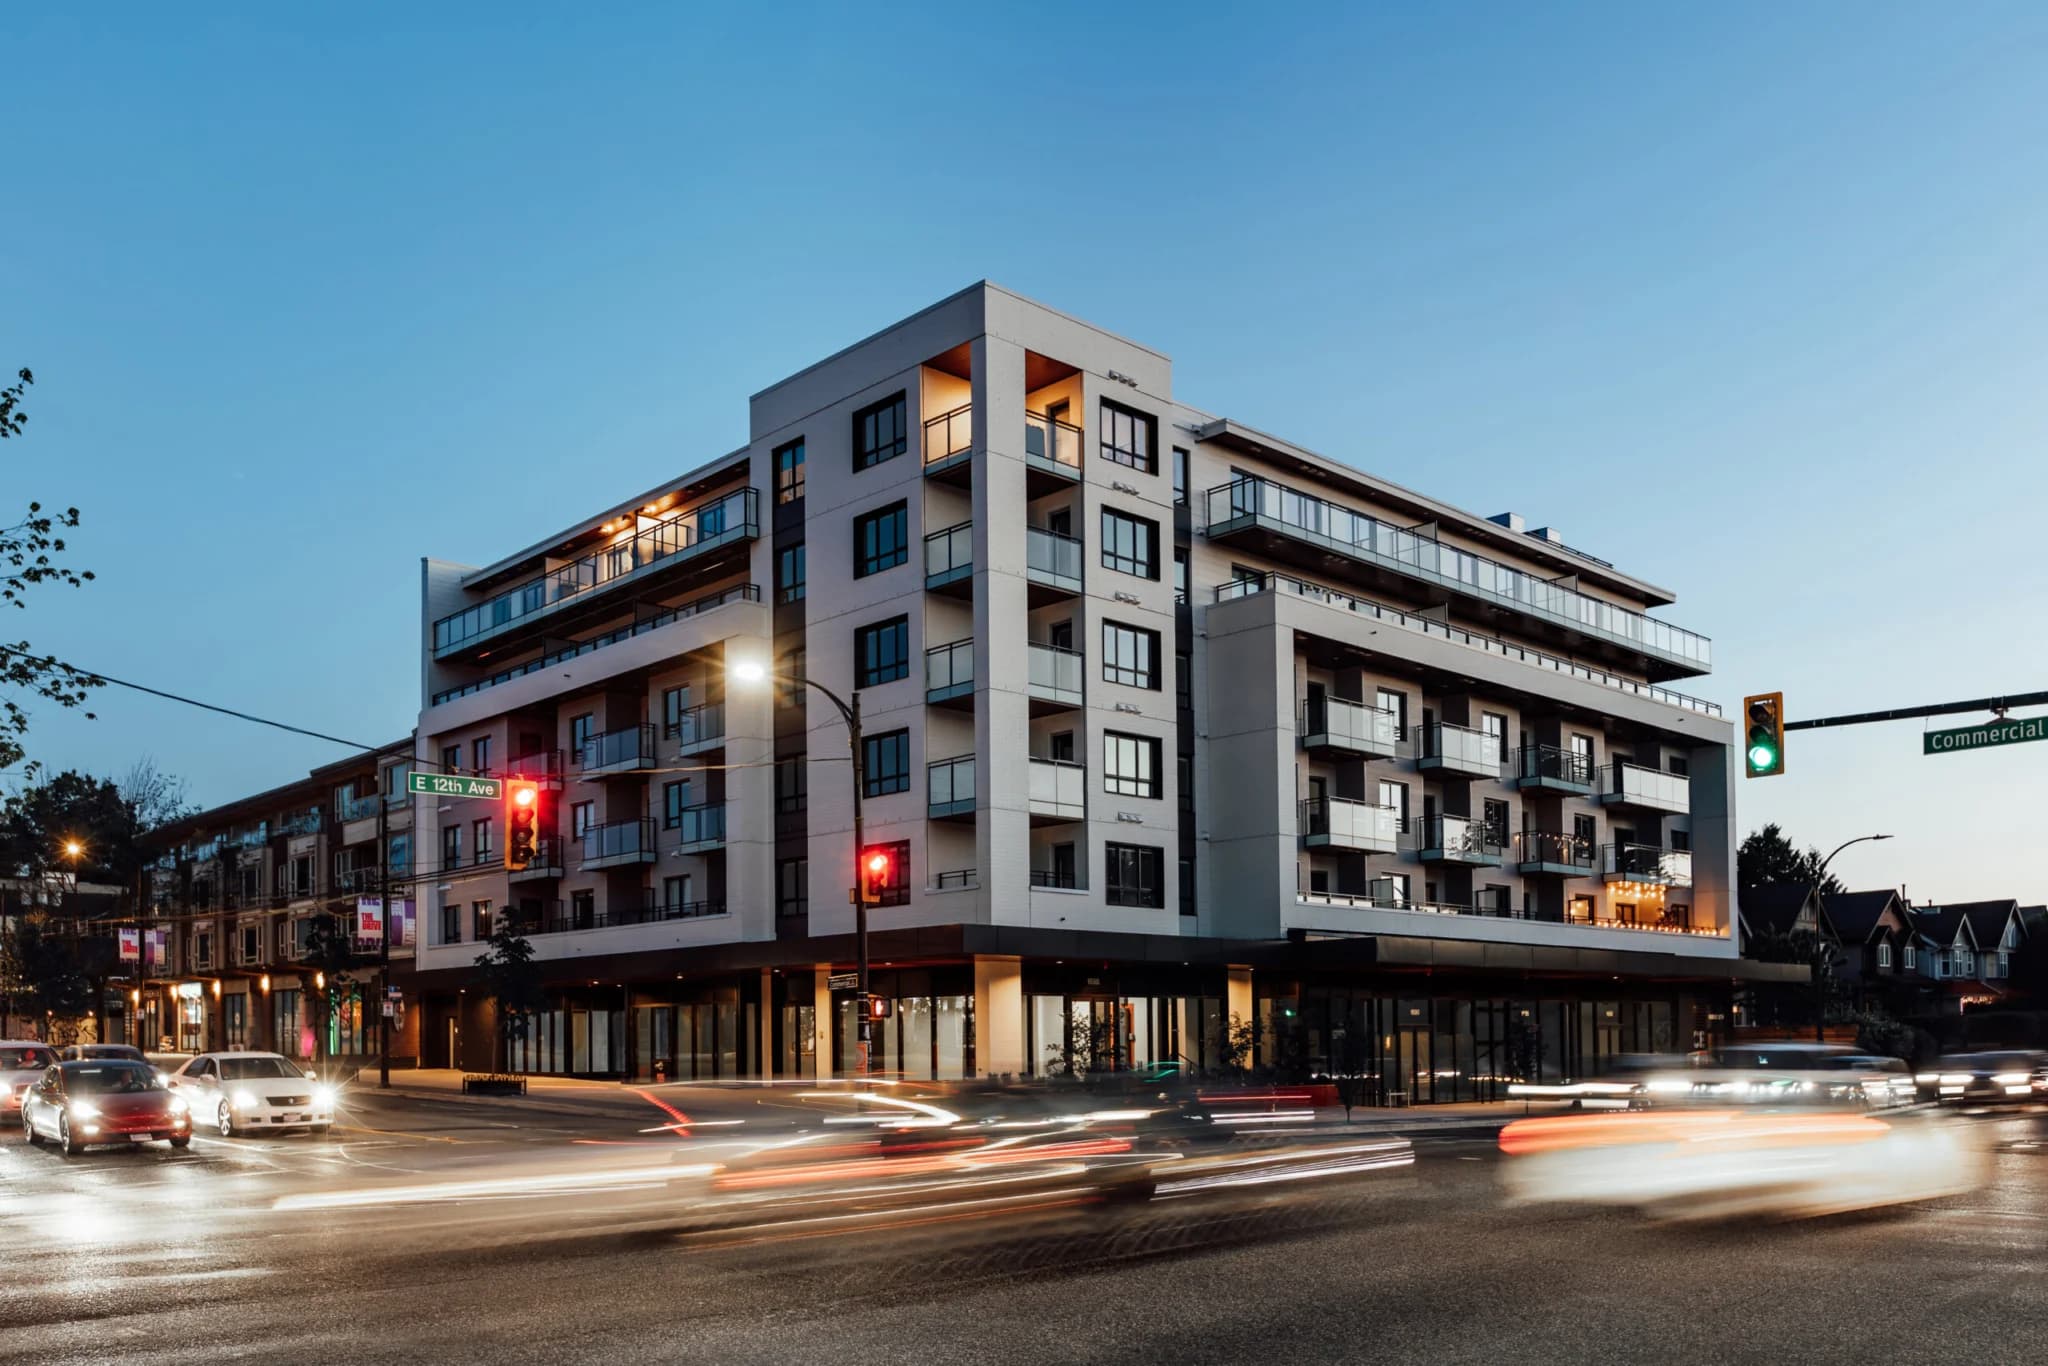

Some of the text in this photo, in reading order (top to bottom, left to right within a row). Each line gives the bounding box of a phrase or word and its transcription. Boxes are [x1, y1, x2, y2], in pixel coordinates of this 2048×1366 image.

[1932, 720, 2044, 749] Commercial
[416, 776, 494, 795] E 12th Ave
